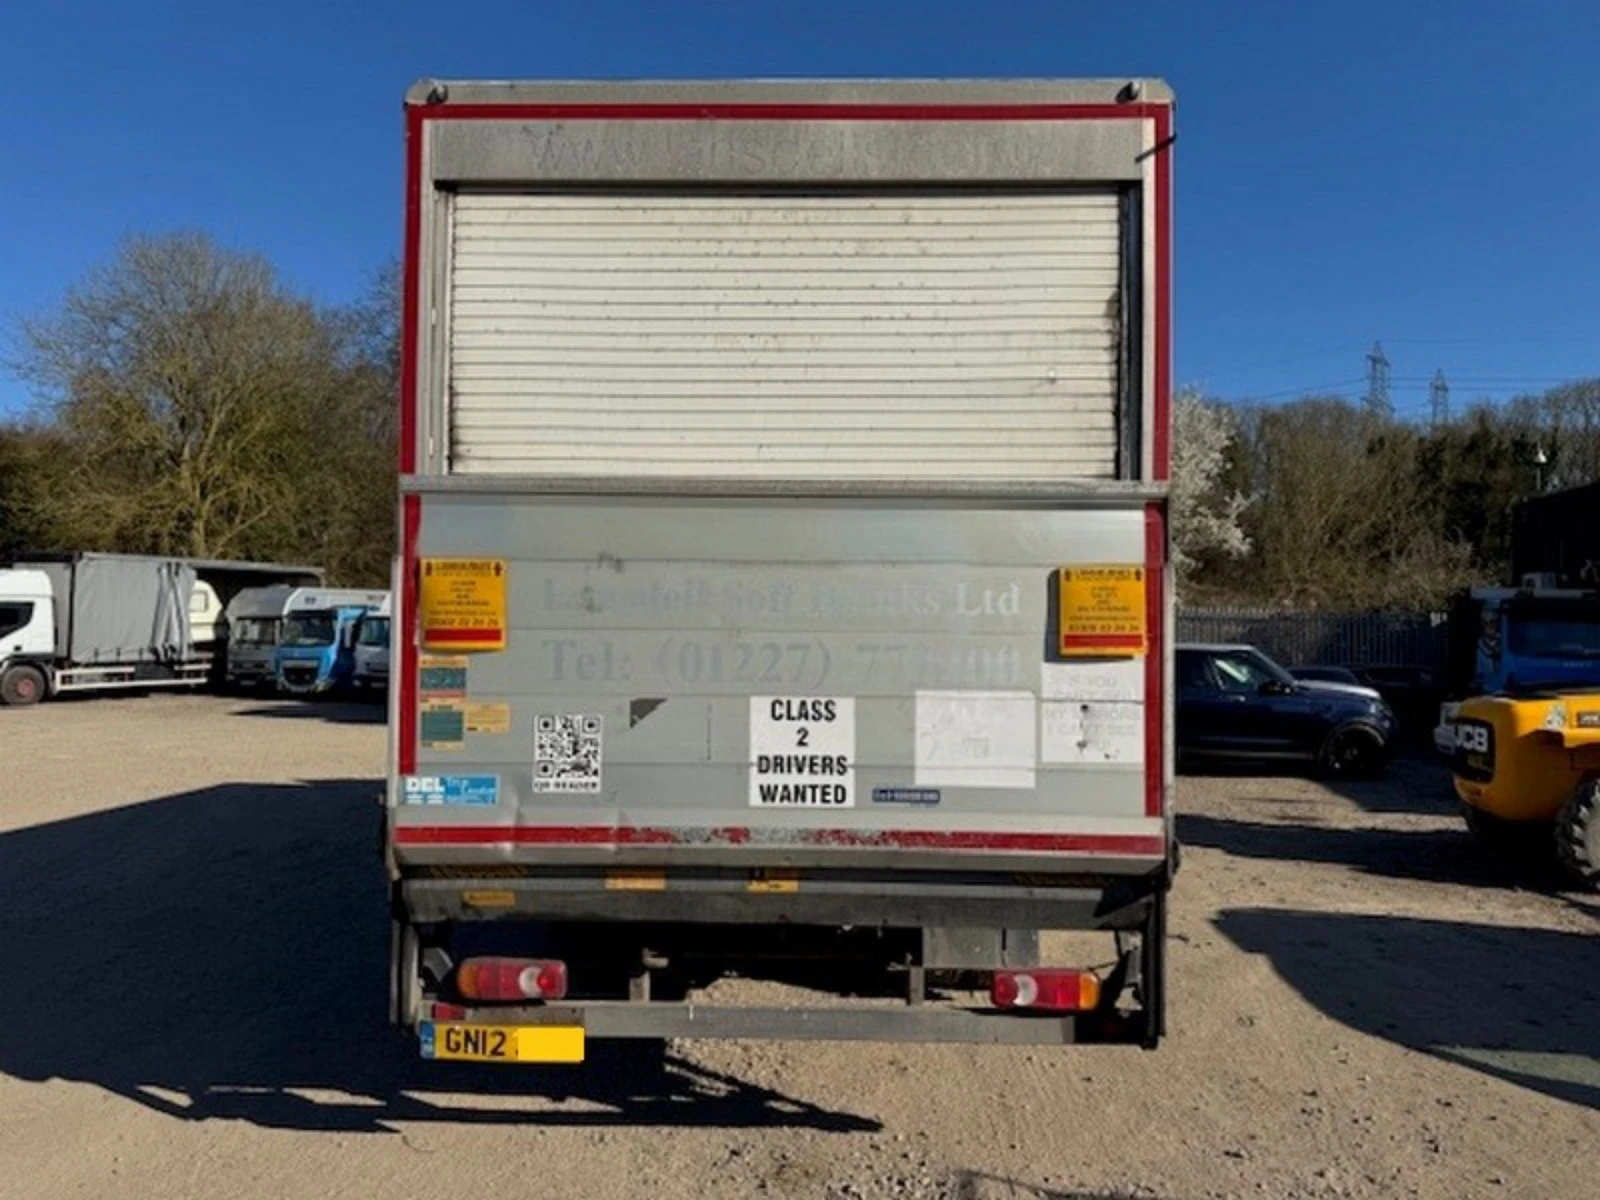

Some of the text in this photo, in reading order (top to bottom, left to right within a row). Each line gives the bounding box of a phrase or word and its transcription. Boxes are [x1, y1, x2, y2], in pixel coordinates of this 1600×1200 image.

[955, 582, 1022, 616] Ltd
[542, 639, 631, 682] Tel:
[655, 635, 832, 690] (01227)
[771, 699, 836, 722] CLASS
[796, 726, 809, 747] 2
[1456, 724, 1489, 752] JCB
[757, 754, 848, 776] DRIVERS
[407, 777, 445, 792] DEL
[760, 783, 847, 804] WANTED
